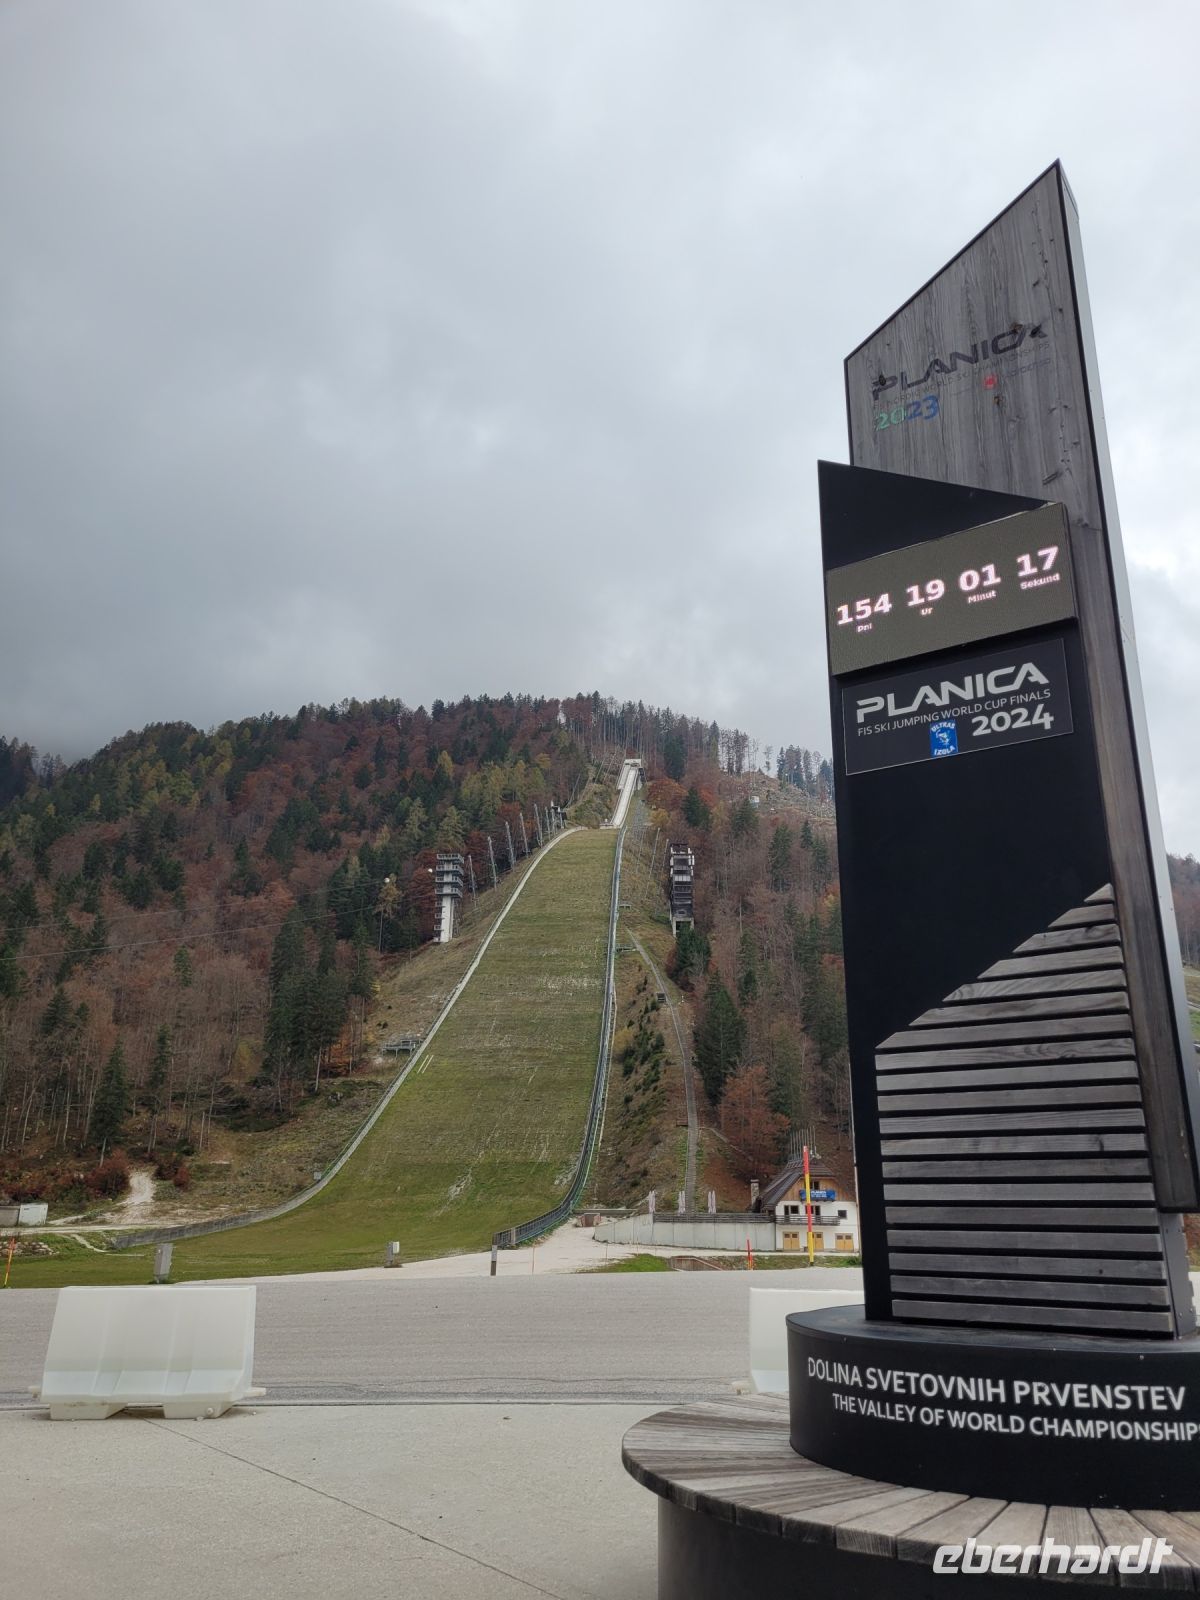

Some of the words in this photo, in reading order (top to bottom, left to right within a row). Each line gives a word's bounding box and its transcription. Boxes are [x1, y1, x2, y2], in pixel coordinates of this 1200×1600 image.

[874, 395, 939, 431] 2023
[837, 593, 892, 625] 154
[906, 579, 945, 606] 19
[958, 563, 1001, 592] 01
[1016, 545, 1059, 576] 17
[967, 590, 997, 604] Minut
[1020, 573, 1060, 590] Sekund
[856, 662, 1049, 723] PLANICA
[857, 725, 873, 737] FIS
[874, 719, 891, 733] SKI
[891, 711, 939, 731] JUMPING
[940, 702, 983, 720] WORLD
[984, 697, 1007, 711] CUP
[1010, 688, 1051, 706] FINALS
[971, 704, 1054, 737] 2024
[933, 745, 956, 756] IZOLA
[807, 1356, 863, 1388] DOLINA
[866, 1367, 1005, 1402] SVETOVNIH
[1013, 1380, 1186, 1411] PRVENSTEV
[832, 1393, 857, 1414] THE
[857, 1398, 917, 1423] VALLEY
[919, 1407, 945, 1426] OF
[947, 1410, 1026, 1434] WORLD
[1029, 1416, 1200, 1442] CHAMPIONSHIP
